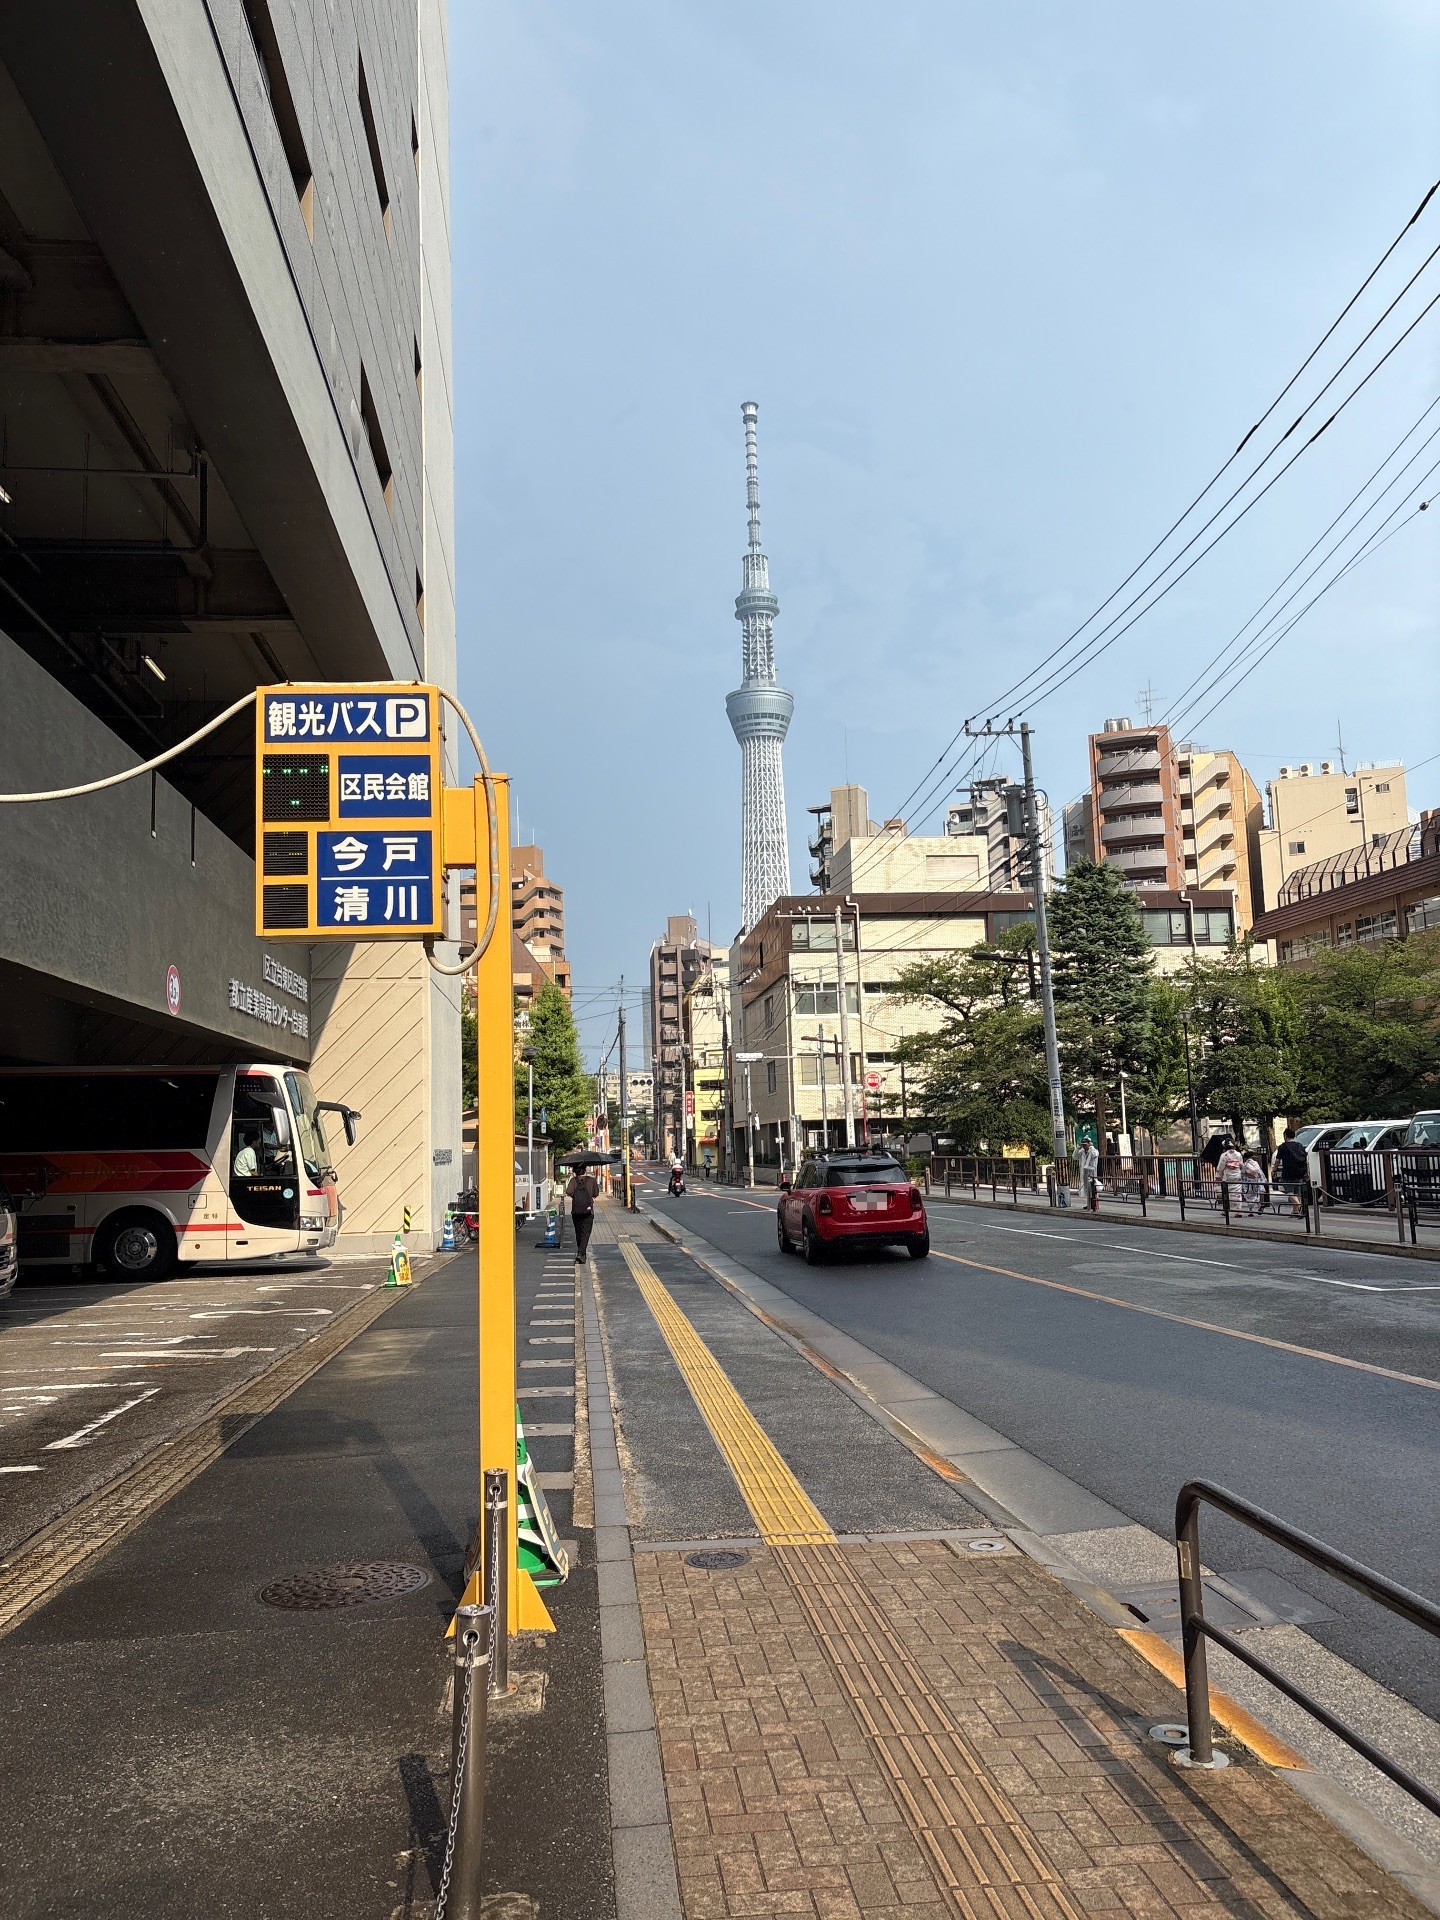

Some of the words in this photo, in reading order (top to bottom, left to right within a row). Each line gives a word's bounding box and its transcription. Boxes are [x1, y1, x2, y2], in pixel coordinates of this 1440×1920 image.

[268, 701, 382, 737] 観光バス
[340, 772, 429, 801] 区民会館
[332, 836, 418, 871] 今戸
[333, 885, 418, 921] 清川
